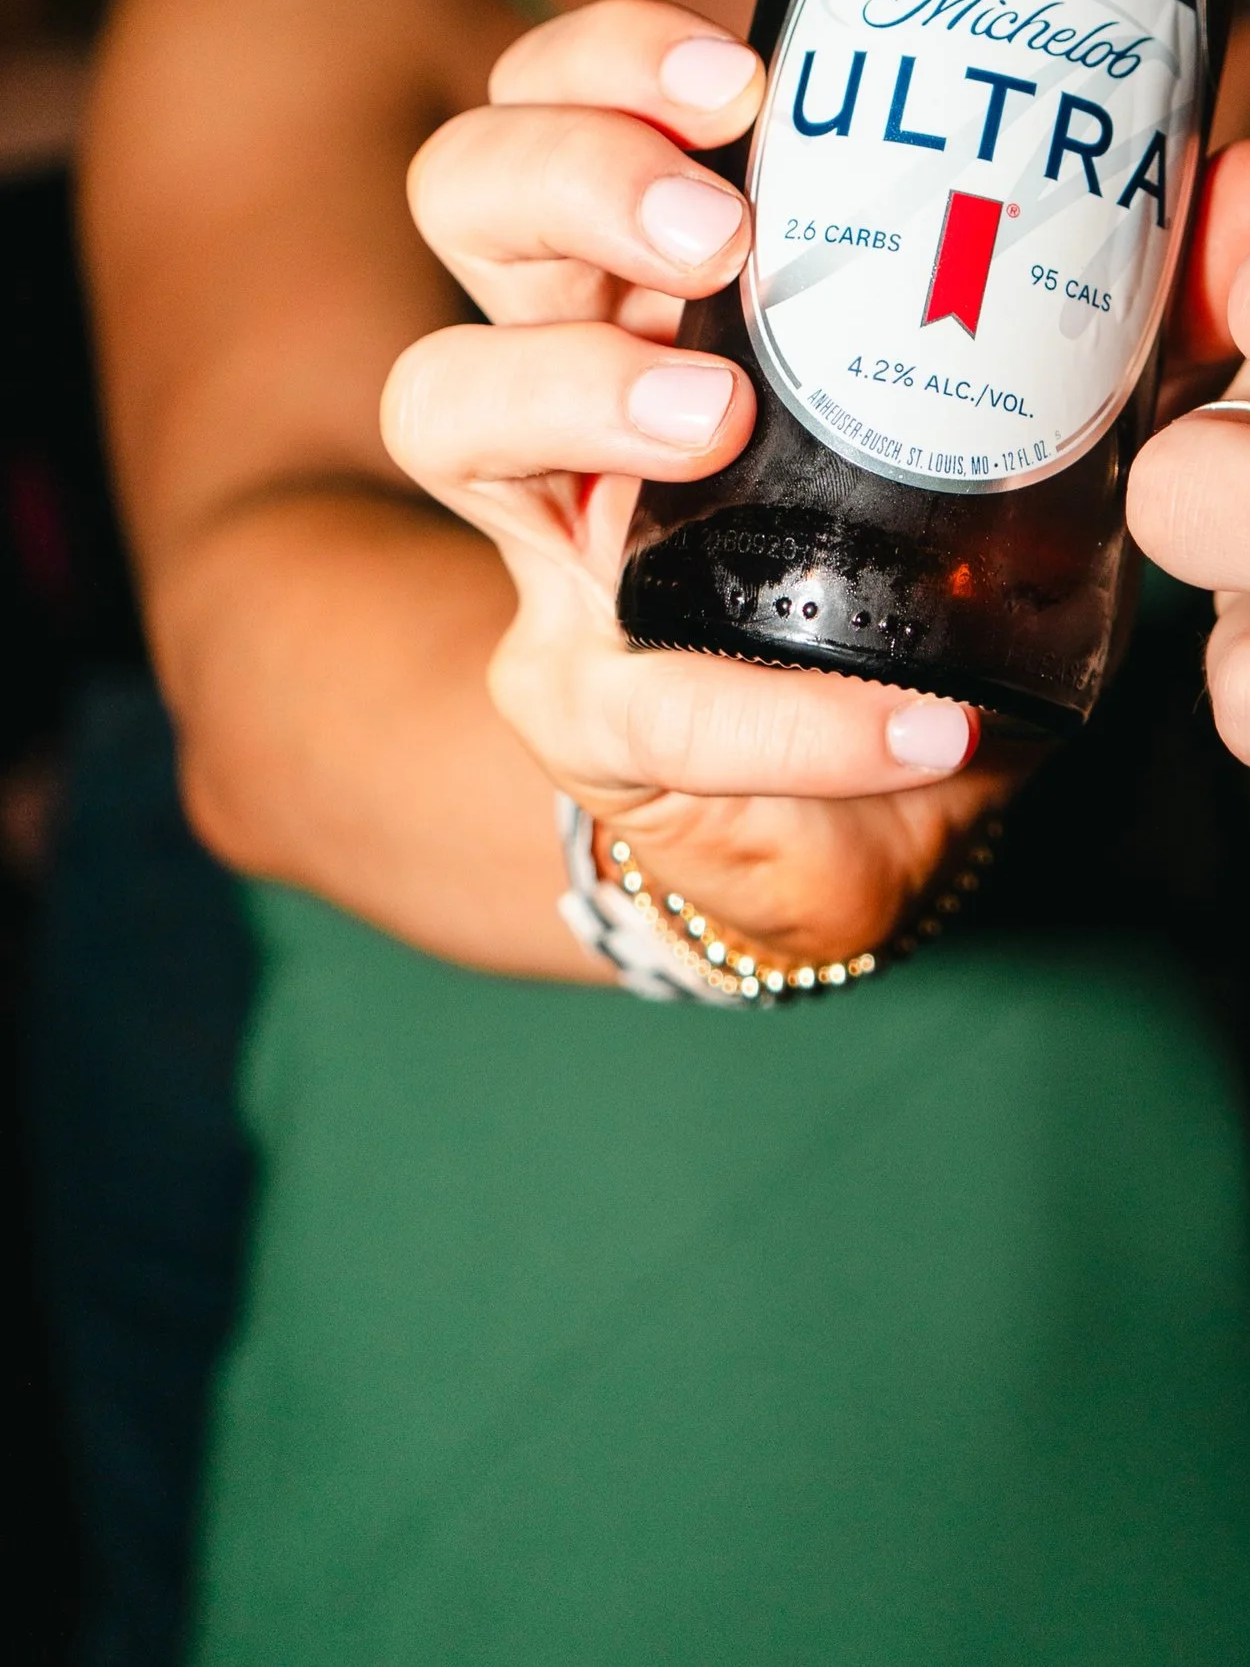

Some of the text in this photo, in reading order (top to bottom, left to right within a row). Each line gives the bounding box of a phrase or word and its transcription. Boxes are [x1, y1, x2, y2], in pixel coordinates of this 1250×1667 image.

[792, 49, 1169, 230] ULTRA
[784, 218, 902, 253] 2.6 CARBS
[1030, 265, 1112, 313] 95 CALS
[847, 355, 1035, 419] 4.2% ALC./VOL.
[807, 388, 1053, 477] ANHEUSER-BUSCH, ST. LOUIS, MO 12 FL. OZ.
